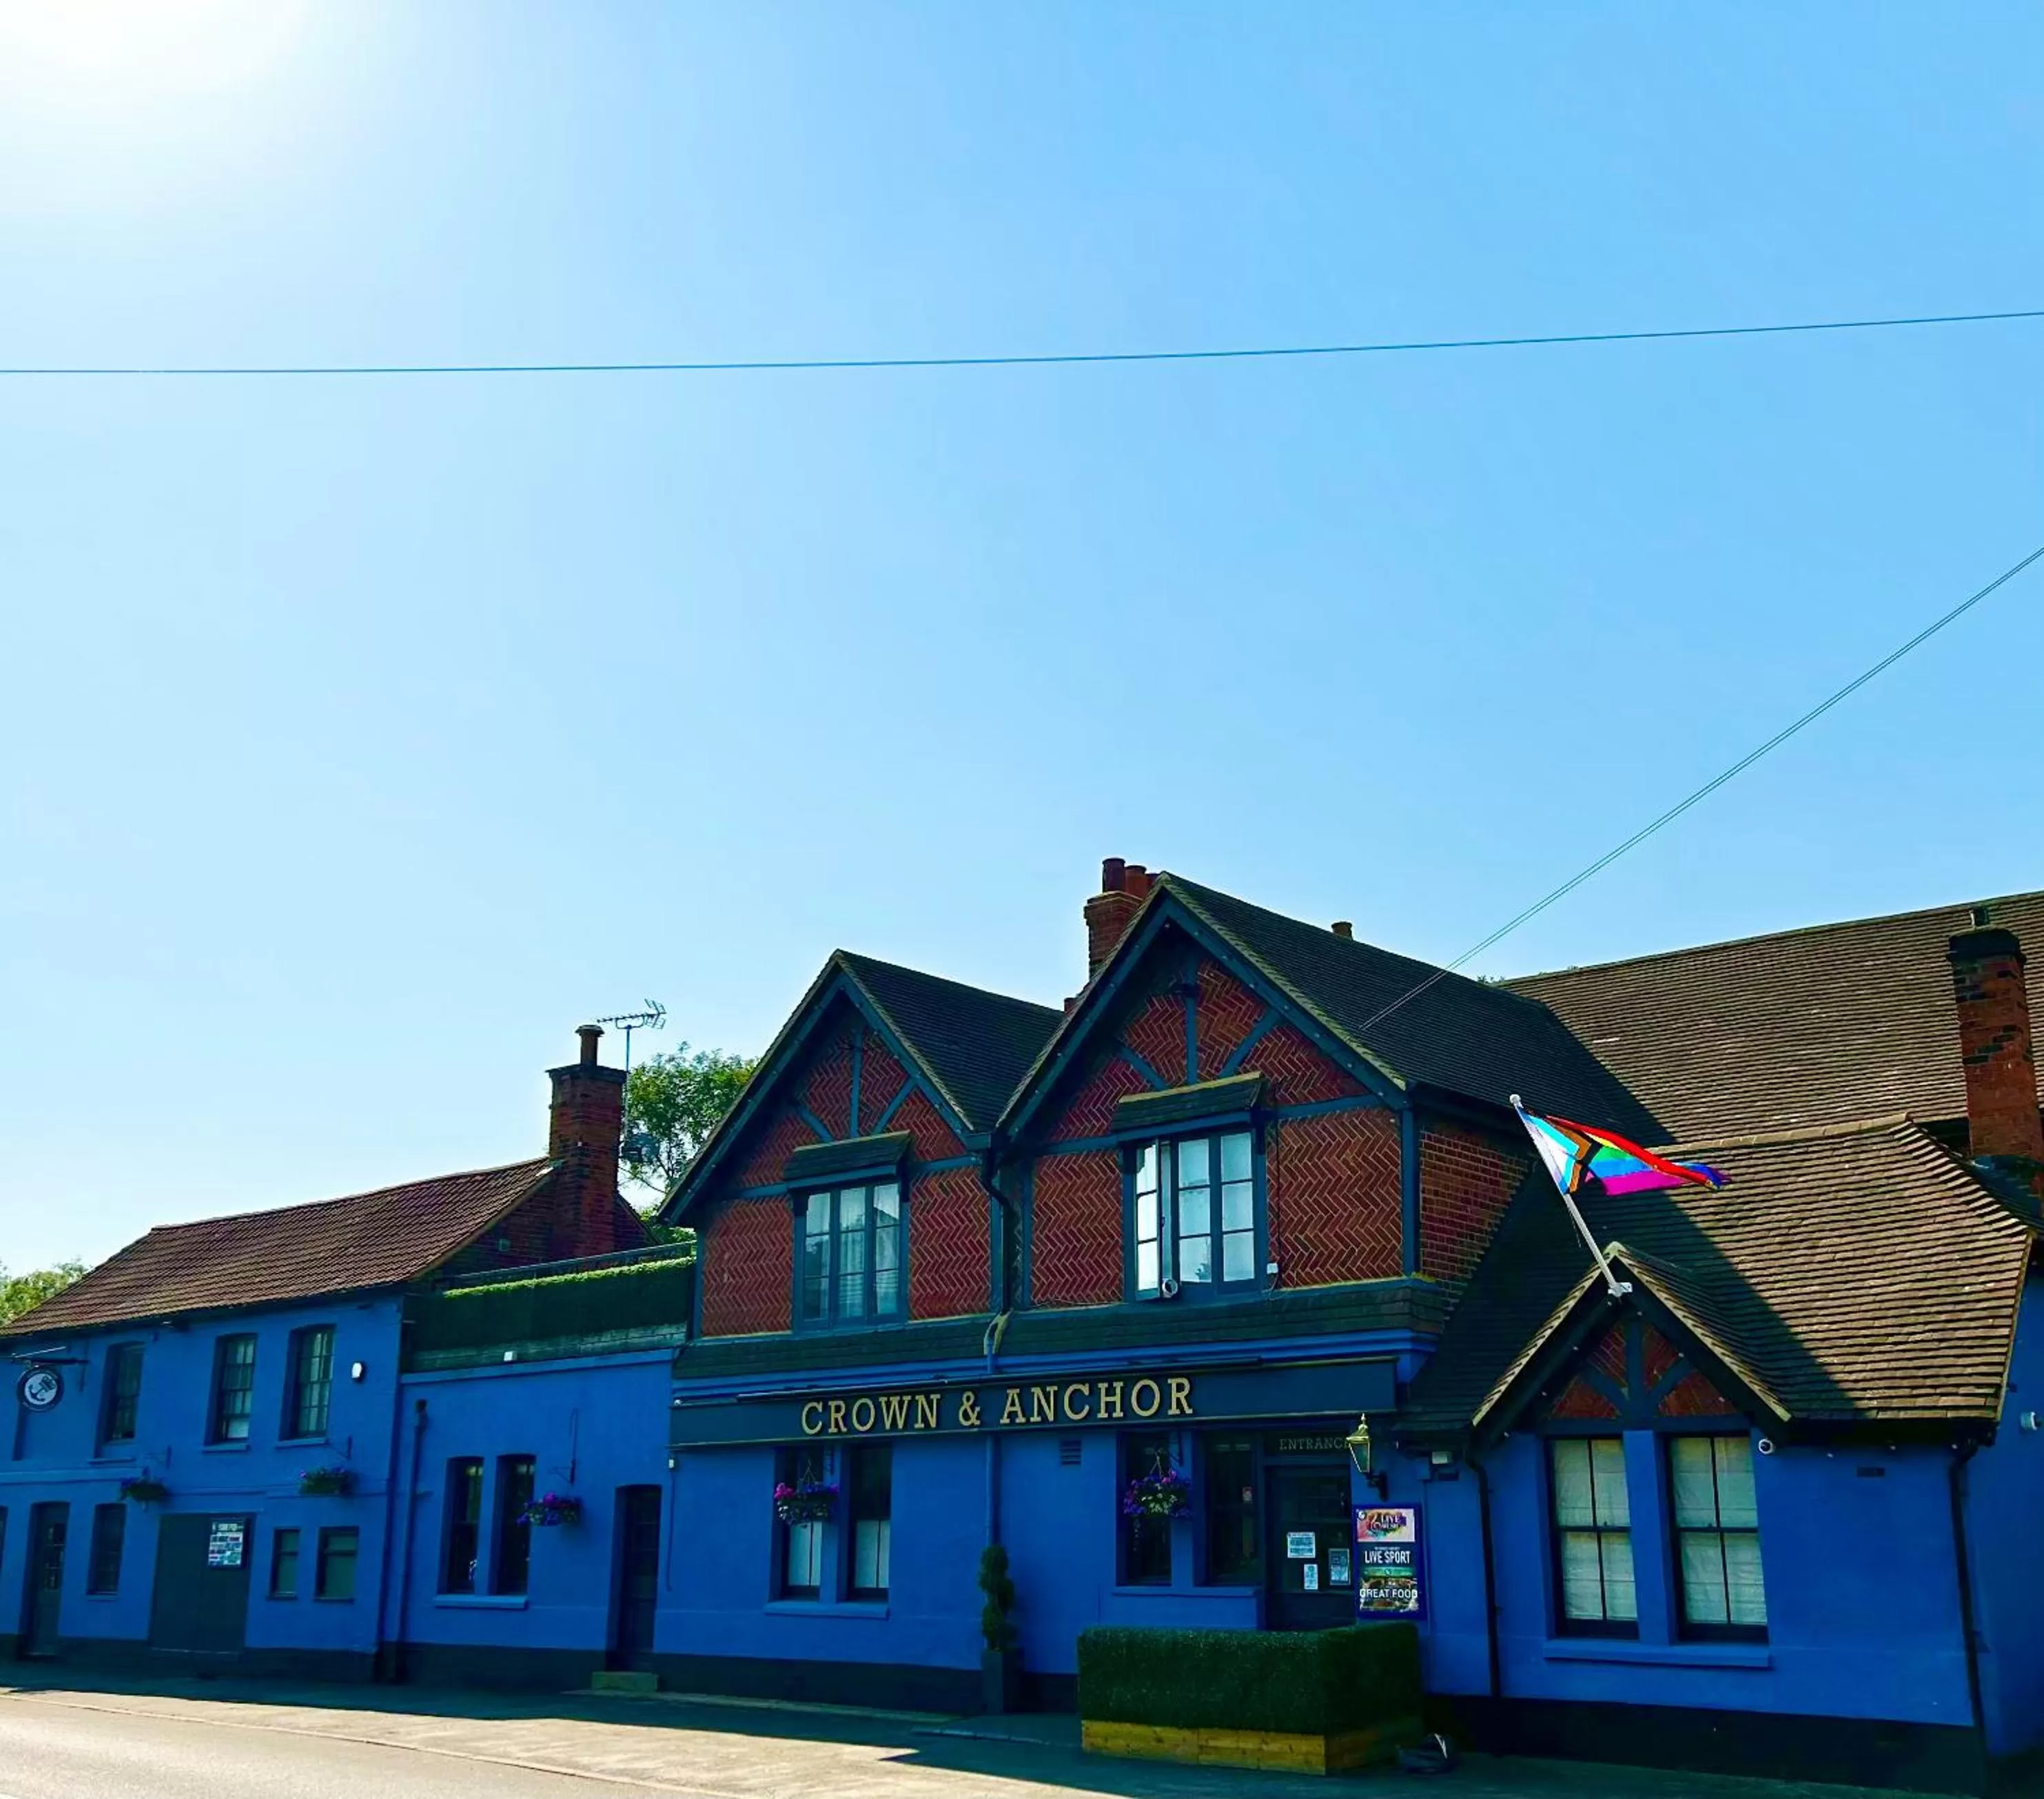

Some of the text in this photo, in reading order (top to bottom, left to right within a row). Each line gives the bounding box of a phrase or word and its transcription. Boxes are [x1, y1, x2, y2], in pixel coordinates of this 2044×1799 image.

[801, 1377, 1194, 1435] CROWN & ANCHOR
[1365, 1550, 1411, 1564] LIVE SPORT
[1360, 1588, 1418, 1598] GREAT FOOD
